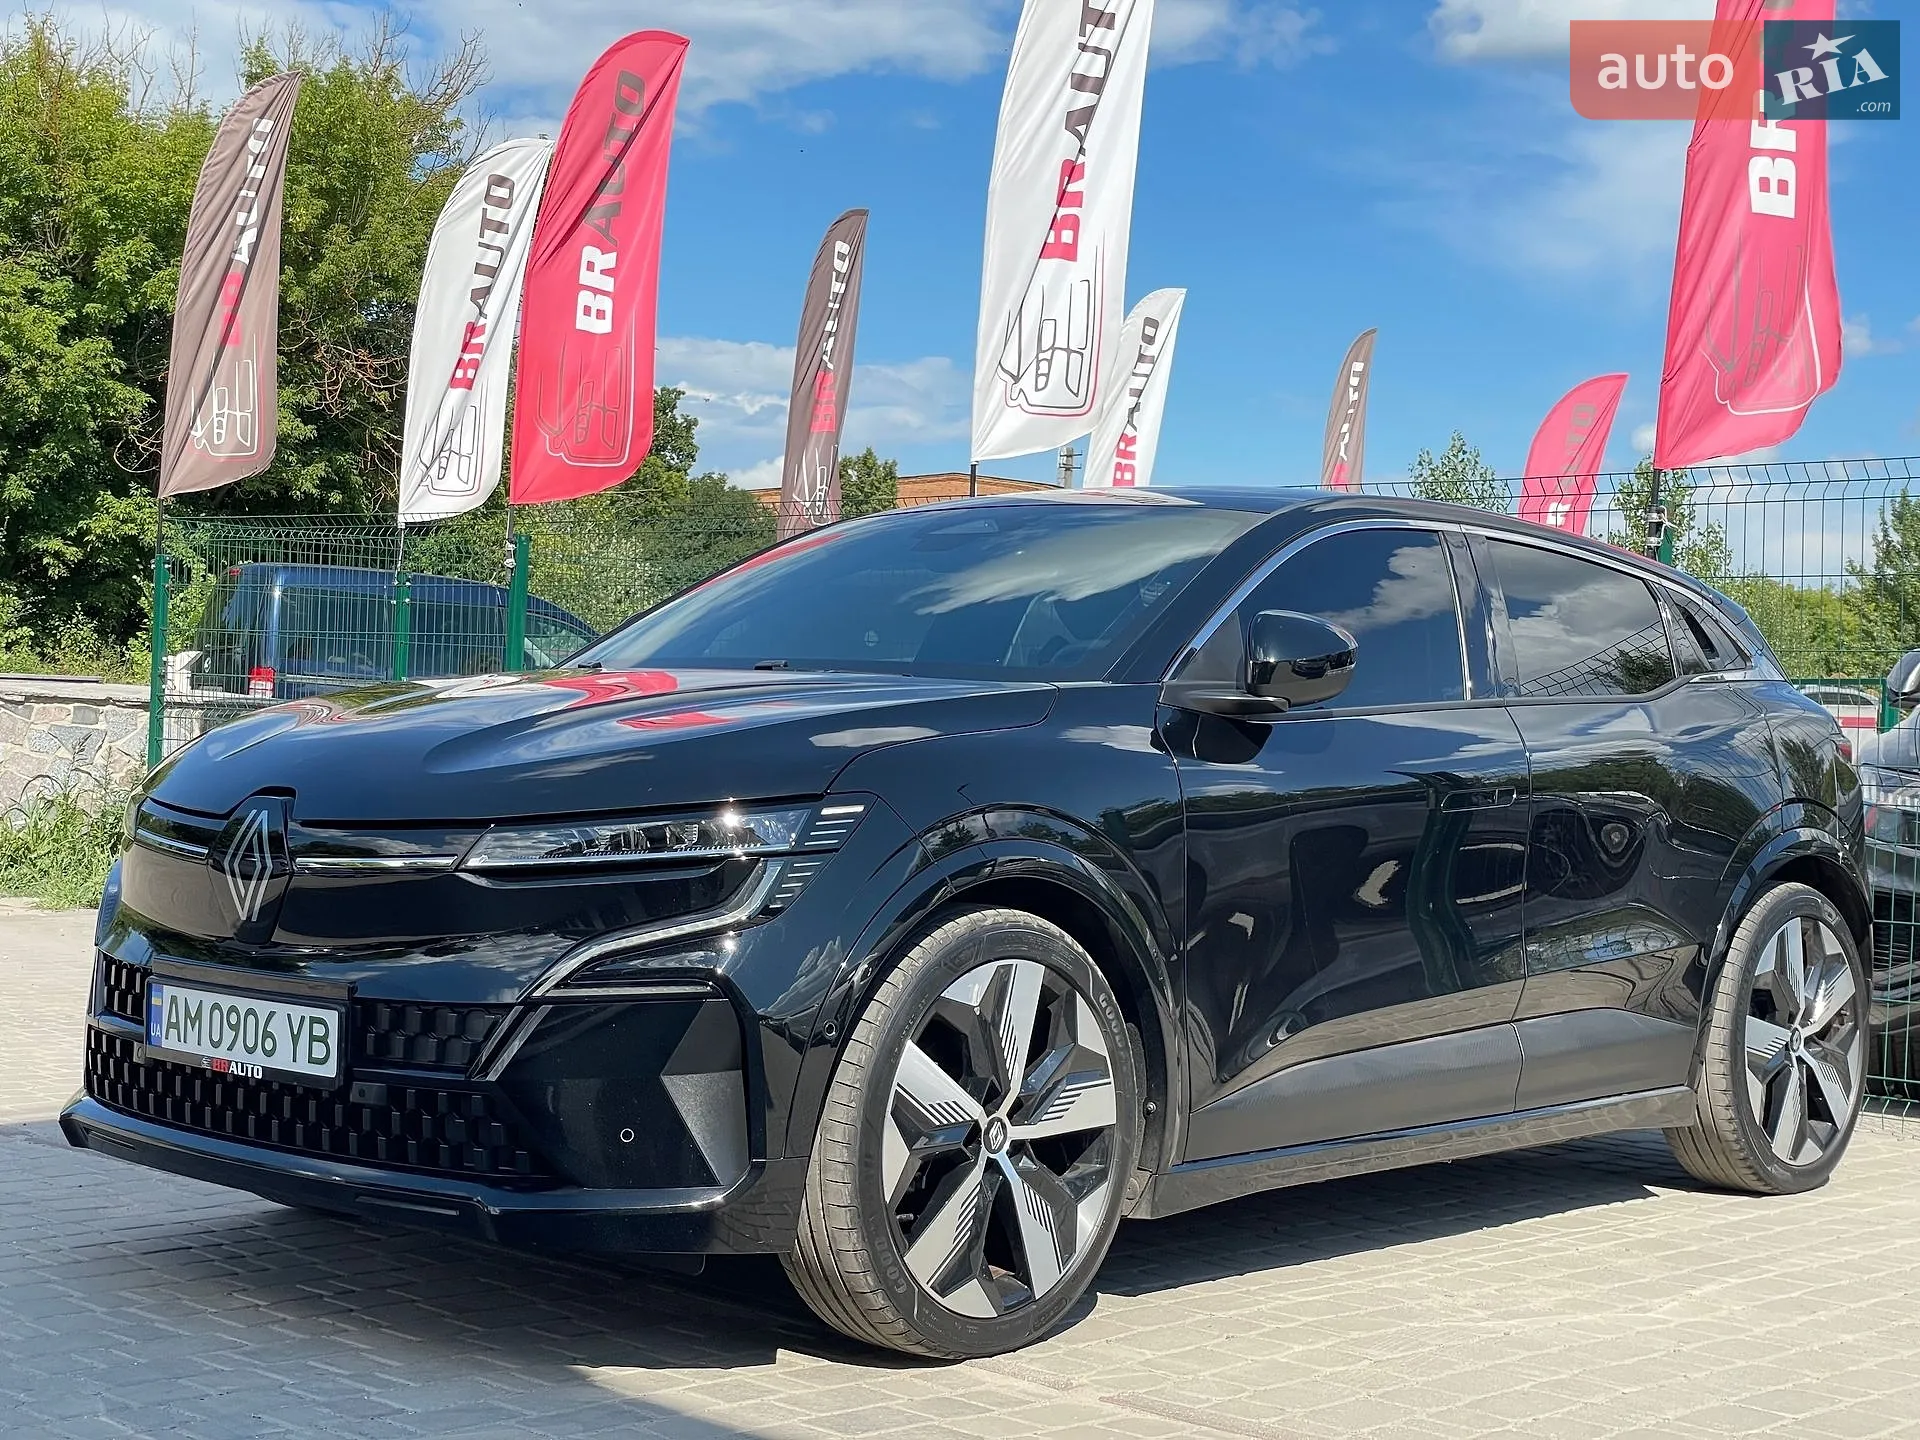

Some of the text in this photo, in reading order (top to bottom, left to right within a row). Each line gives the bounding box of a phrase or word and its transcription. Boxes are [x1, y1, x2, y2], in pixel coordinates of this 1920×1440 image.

[575, 69, 645, 334] BRAUTO
[1039, 0, 1116, 262] BRAUT
[449, 173, 515, 391] BRAUTO
[150, 1021, 162, 1038] UA
[164, 995, 331, 1066] AM 0906 YB
